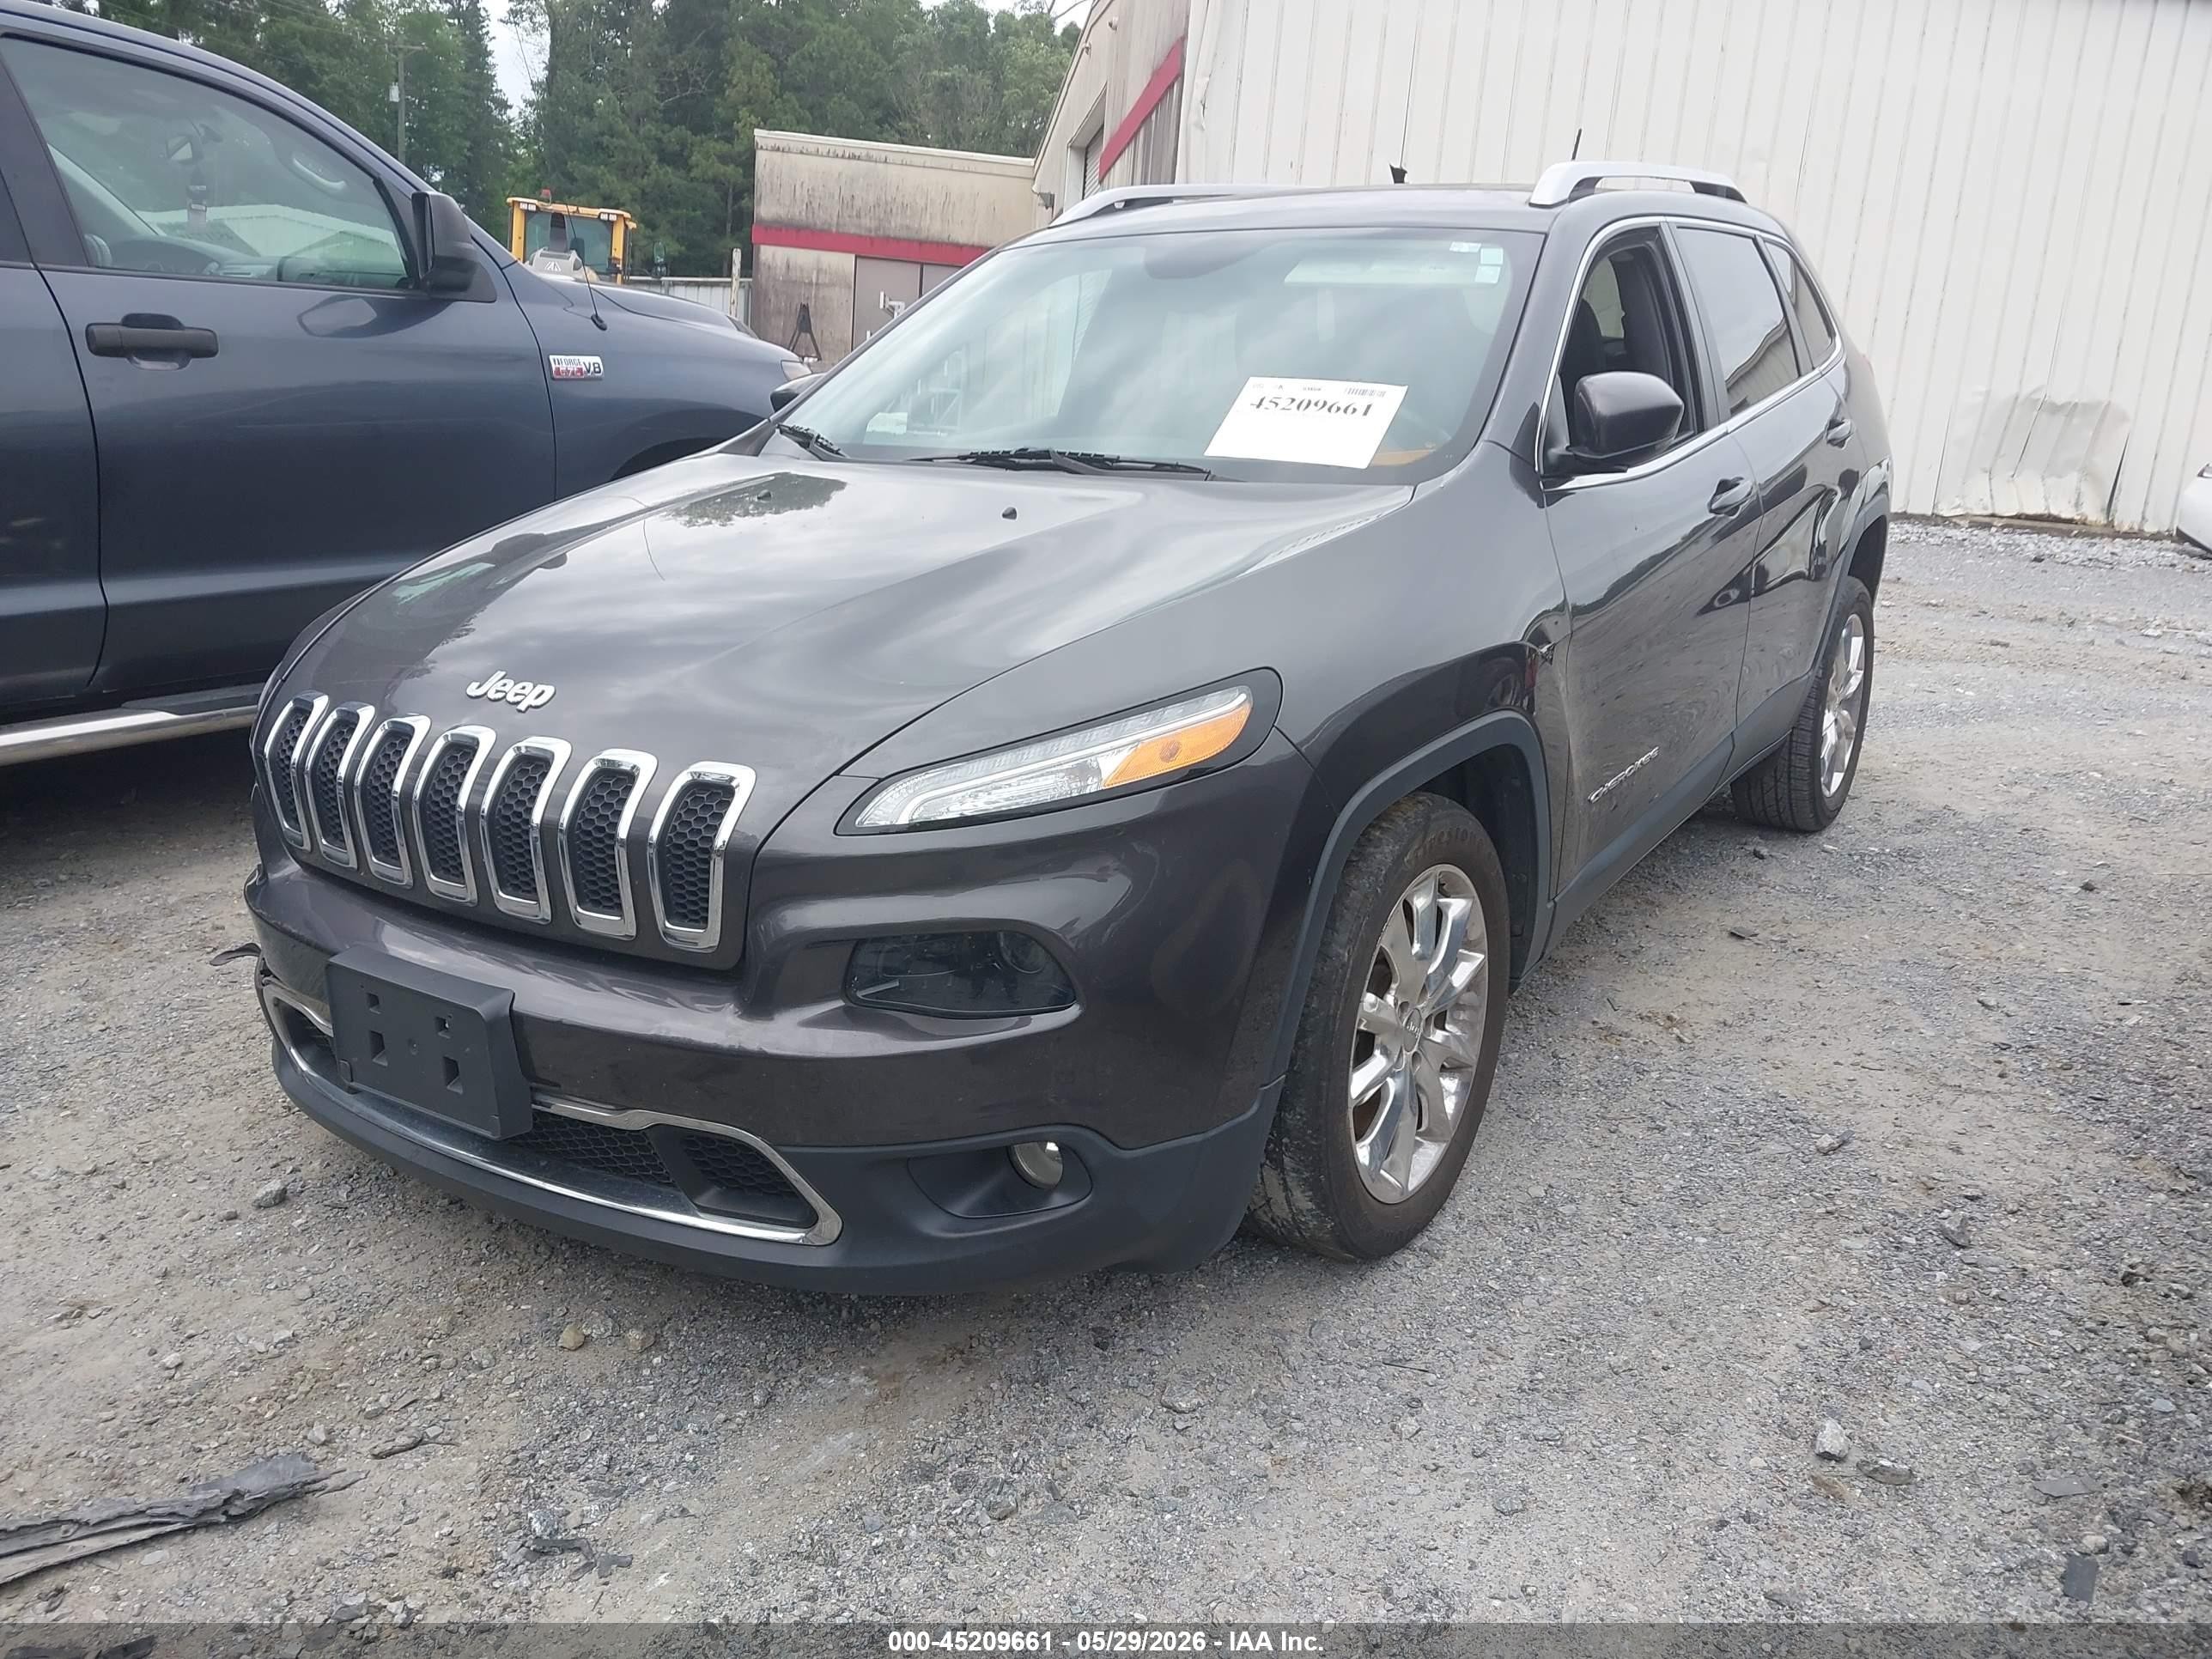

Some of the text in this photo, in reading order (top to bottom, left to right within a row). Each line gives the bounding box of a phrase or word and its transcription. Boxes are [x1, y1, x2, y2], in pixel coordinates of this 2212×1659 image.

[583, 362, 602, 374] V8
[1250, 396, 1373, 416] 45209661
[466, 671, 556, 713] Jeep
